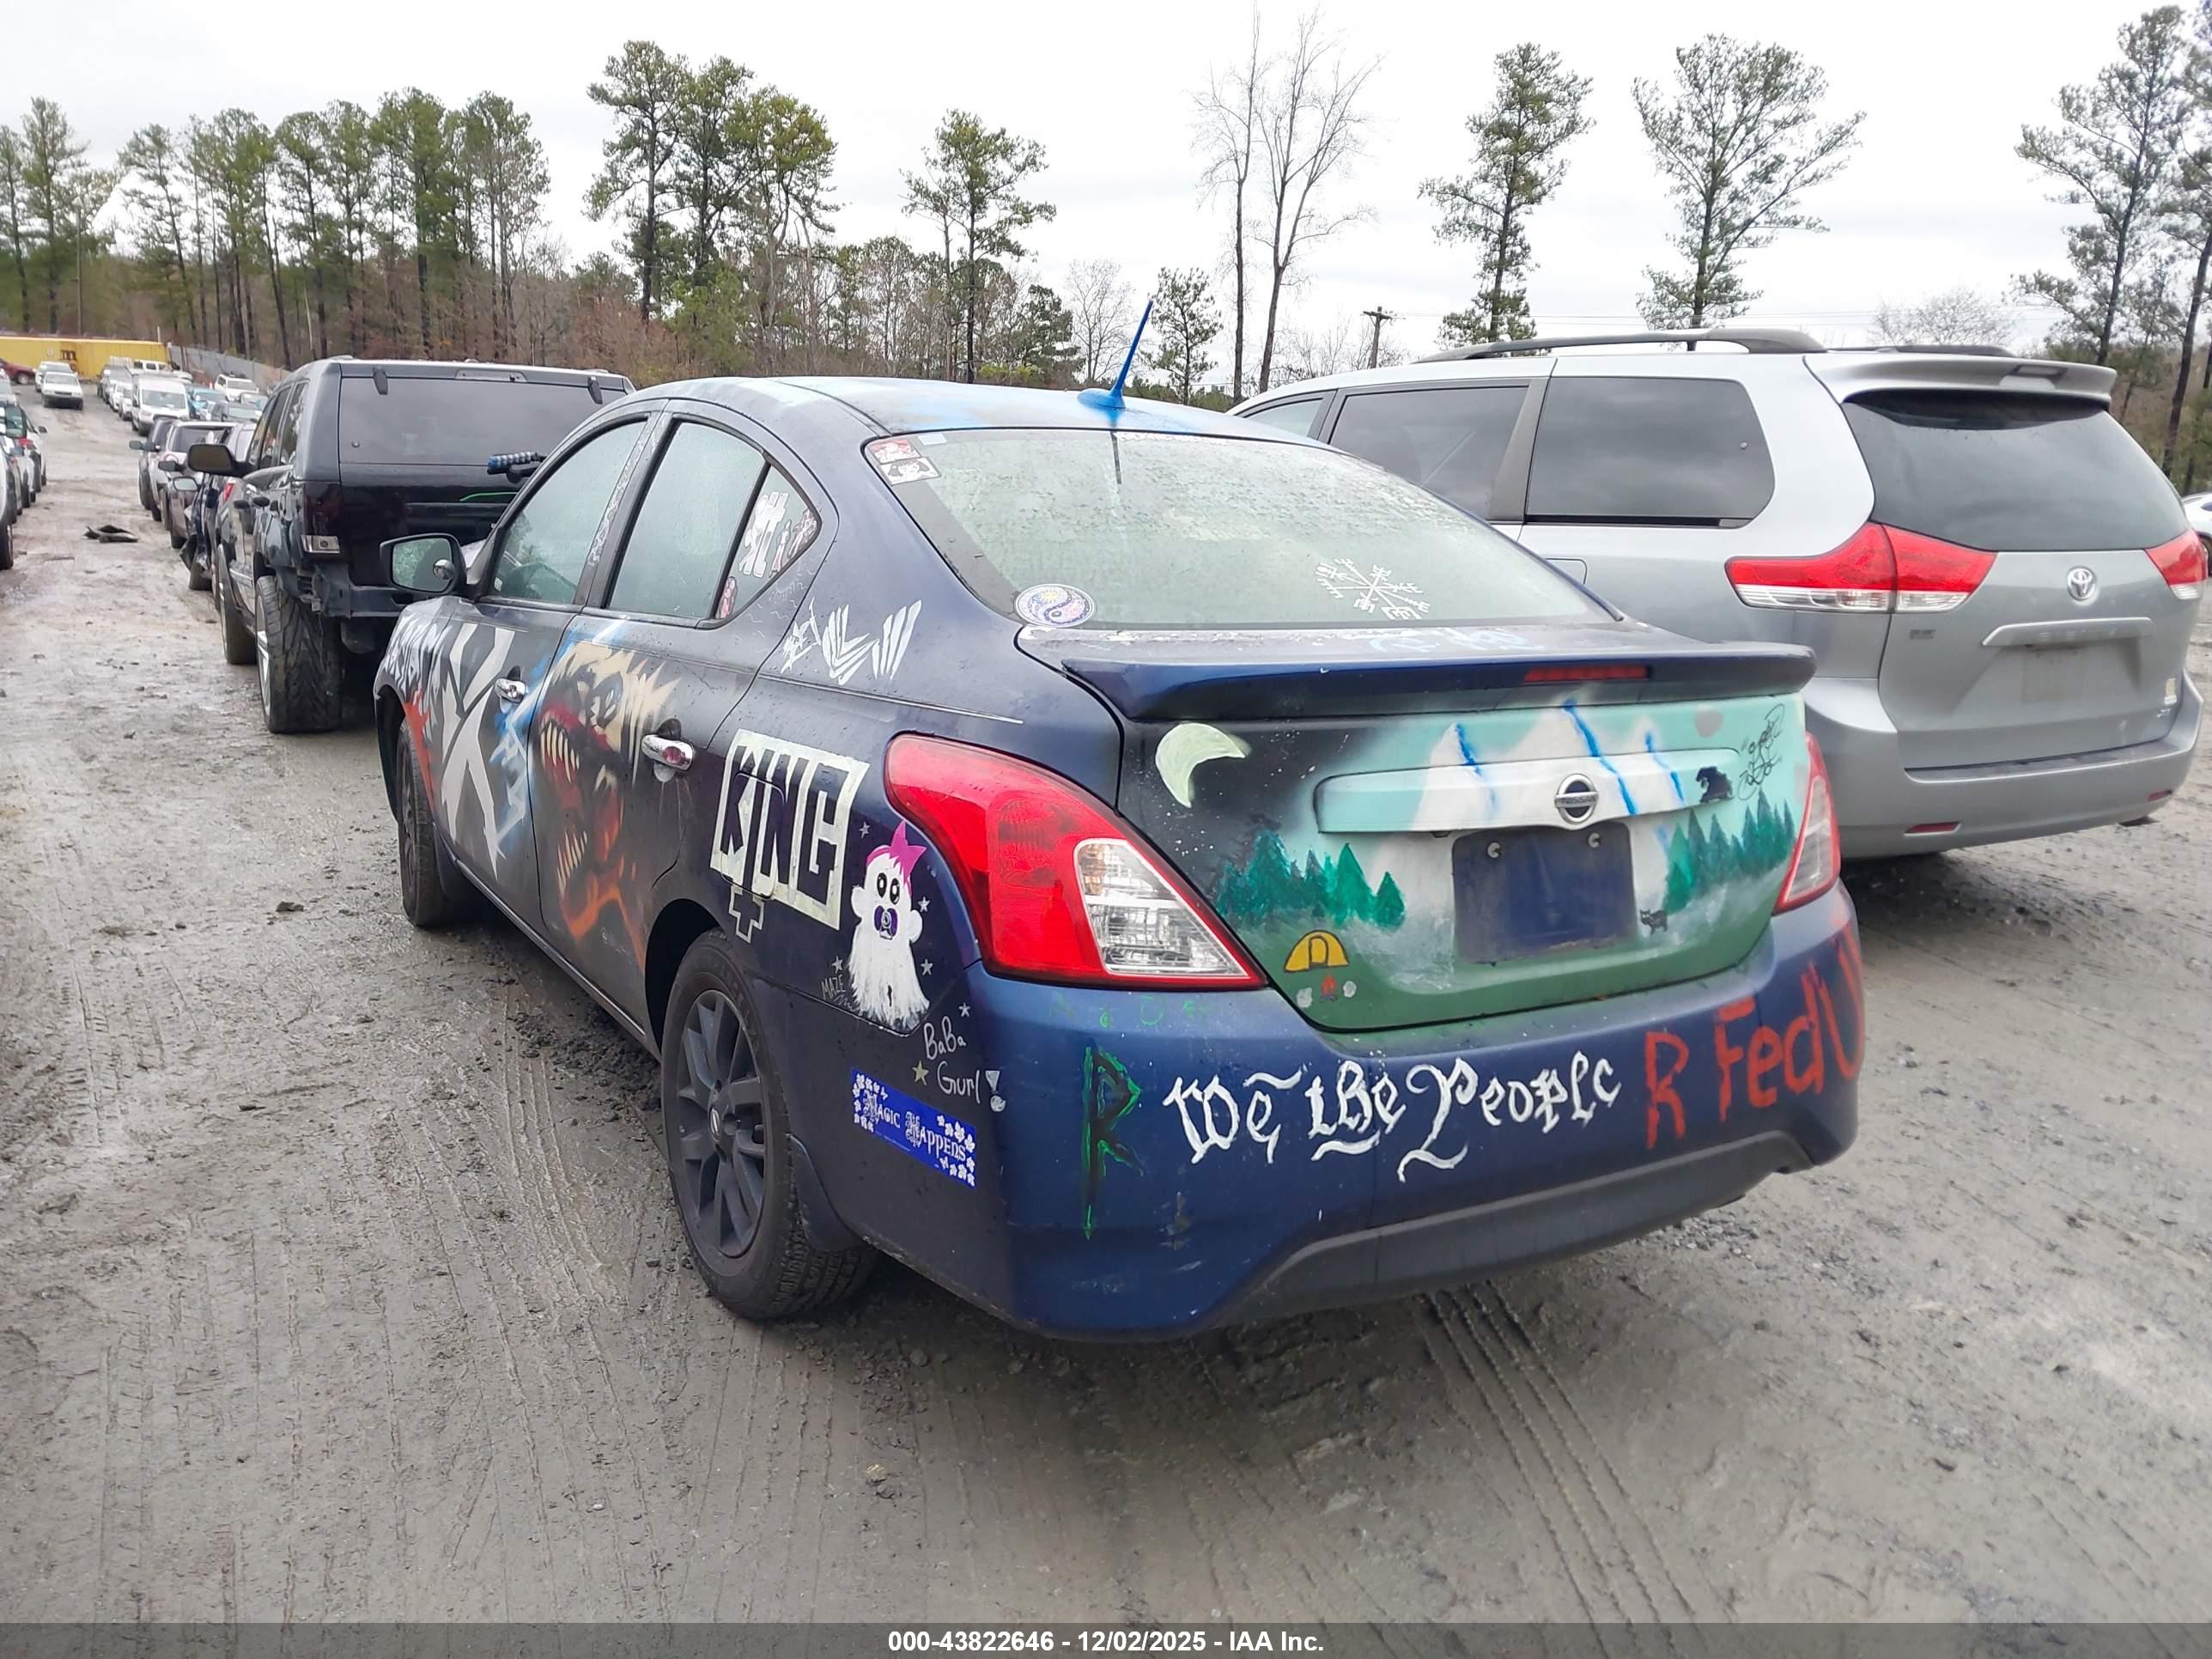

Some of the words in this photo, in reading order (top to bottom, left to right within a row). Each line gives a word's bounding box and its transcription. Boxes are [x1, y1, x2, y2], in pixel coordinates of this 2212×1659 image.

[720, 745, 850, 906] KING
[822, 974, 846, 1000] MAZE
[1163, 1072, 1295, 1163] We
[1645, 1031, 1689, 1150] R
